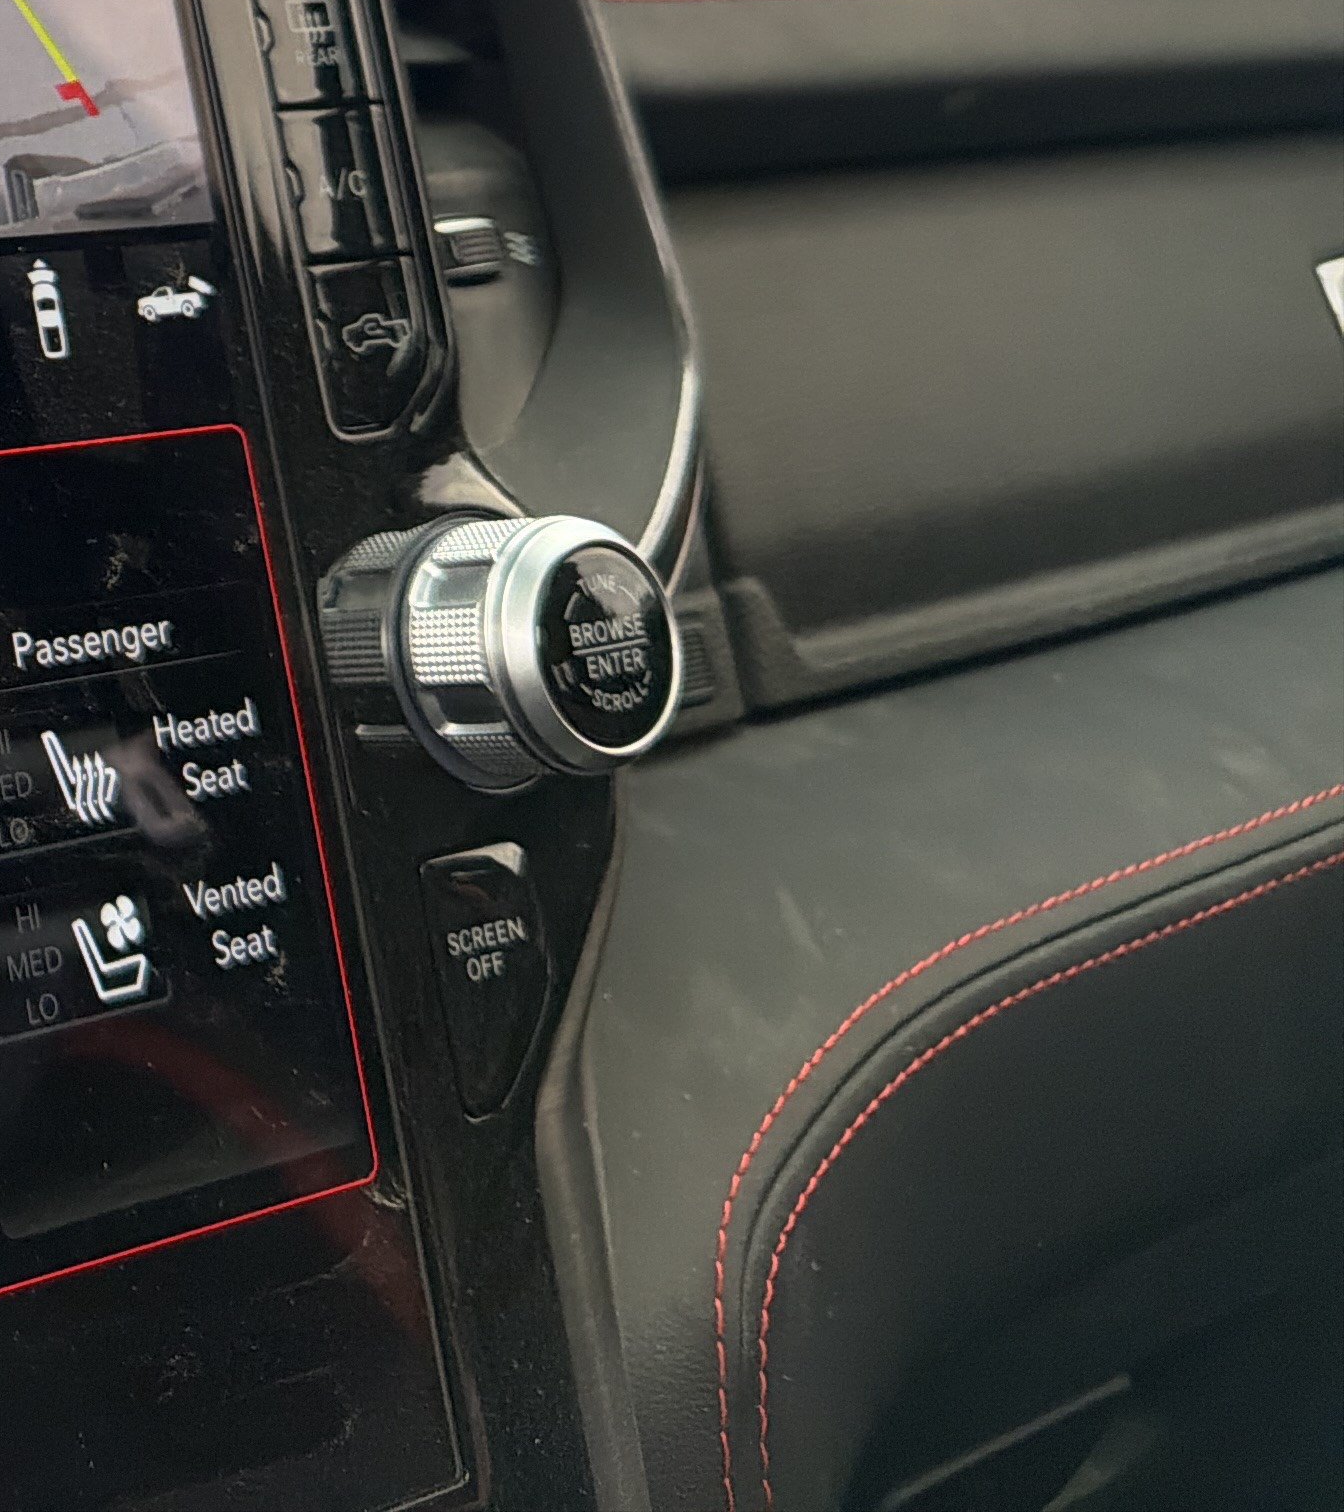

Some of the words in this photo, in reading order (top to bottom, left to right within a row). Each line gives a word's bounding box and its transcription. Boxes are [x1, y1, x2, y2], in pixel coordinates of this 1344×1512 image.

[295, 46, 340, 68] REAR
[317, 170, 367, 201] A/C
[575, 574, 617, 594] TUNE
[11, 616, 173, 671] Passenger
[569, 614, 644, 644] BROWSE
[587, 648, 642, 680] ENTER
[591, 684, 649, 713] SCROLL
[153, 697, 257, 750] Heated
[182, 760, 248, 800] Seat
[184, 863, 283, 919] Vented
[15, 905, 41, 931] HI
[212, 926, 277, 968] Seat
[447, 918, 525, 957] SCREEN
[7, 946, 62, 982] MED
[465, 951, 503, 980] OFF
[25, 993, 59, 1025] LO
